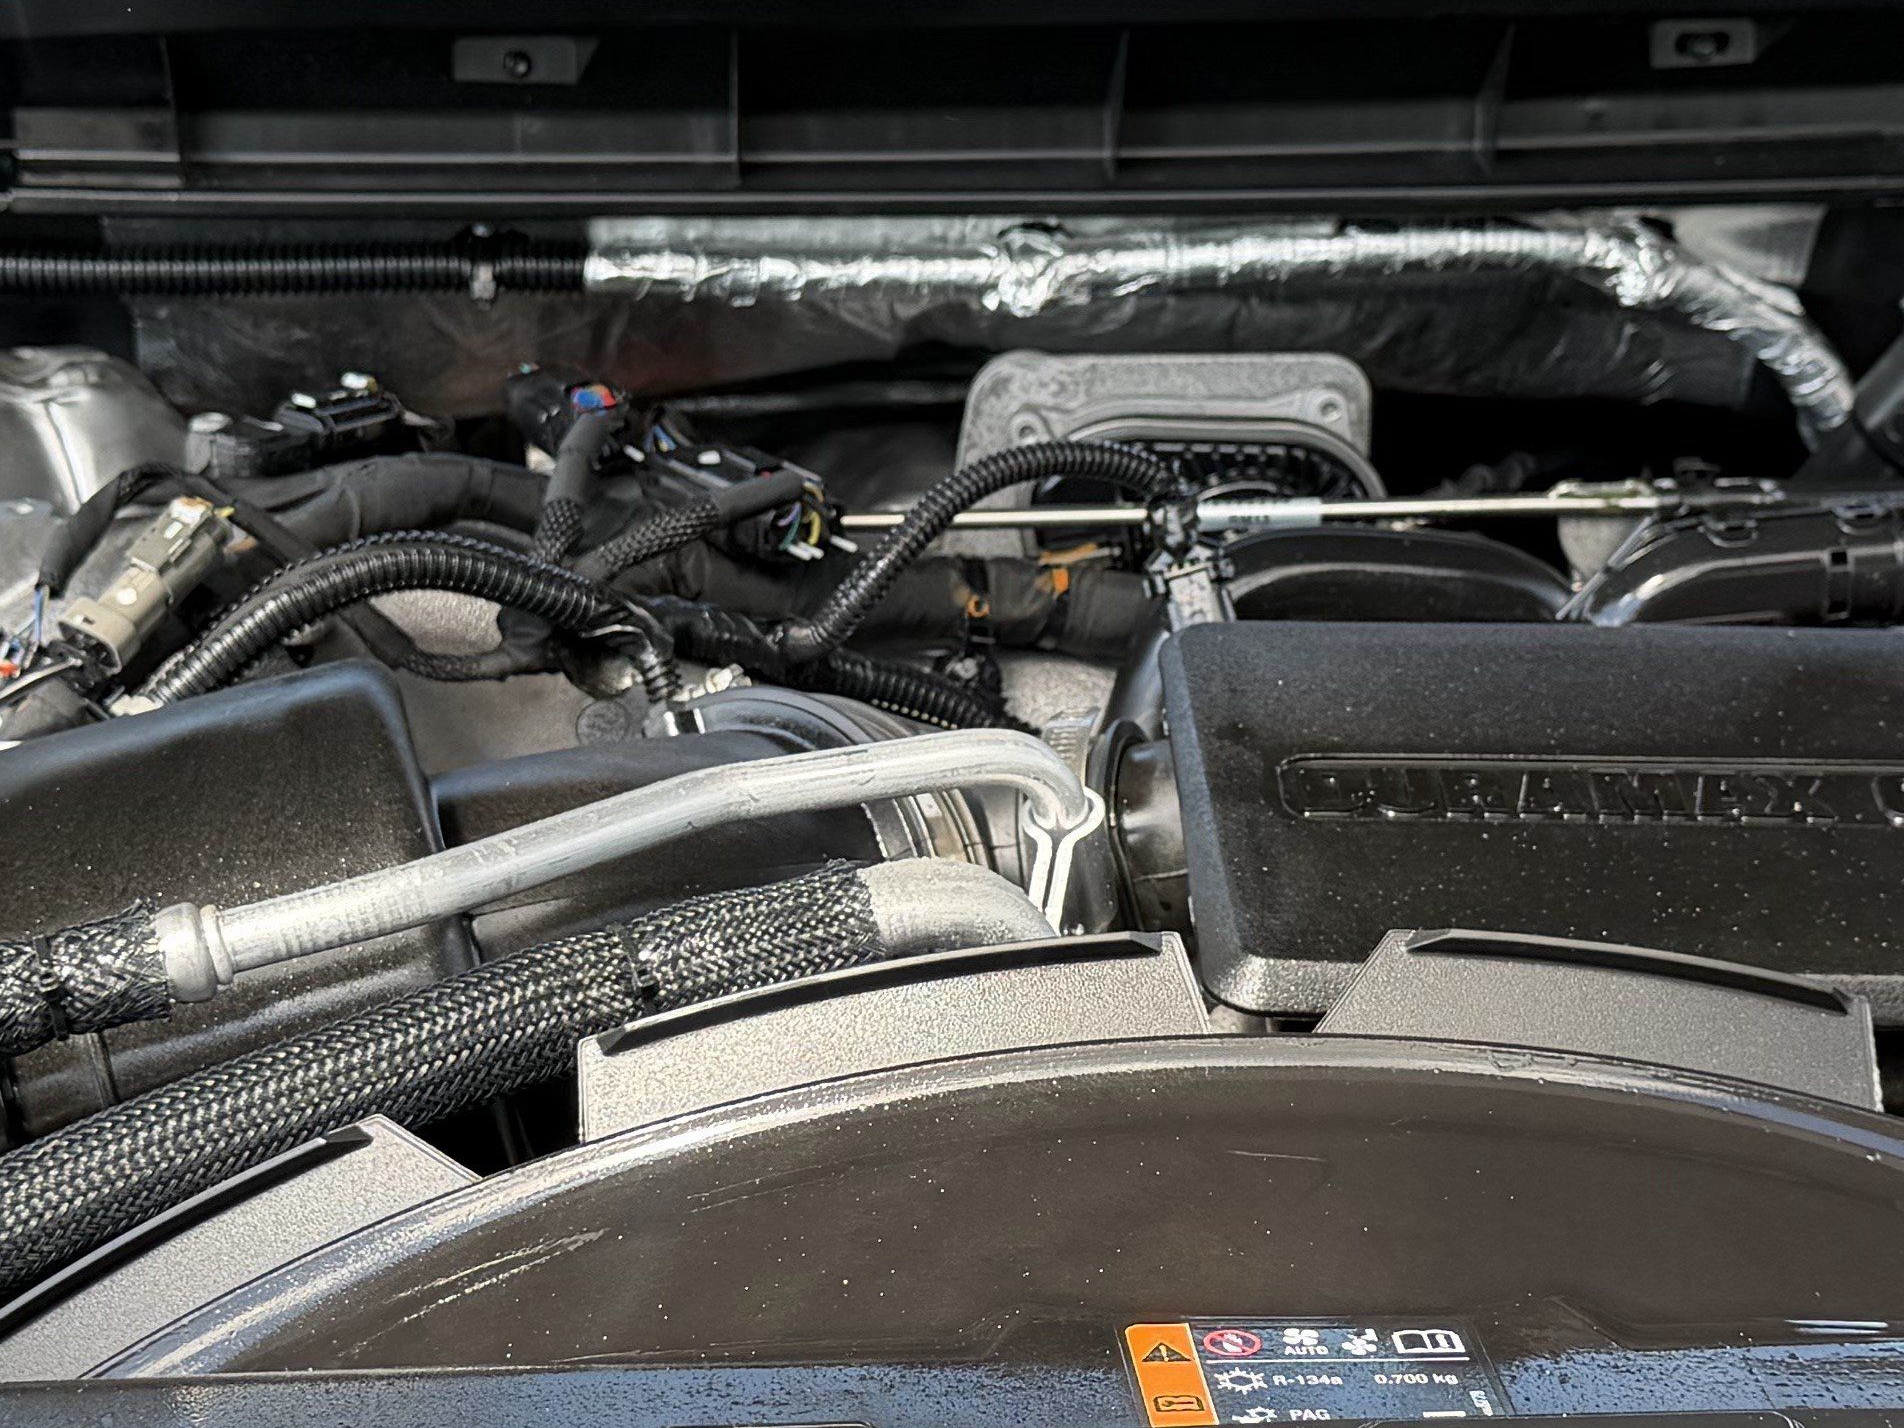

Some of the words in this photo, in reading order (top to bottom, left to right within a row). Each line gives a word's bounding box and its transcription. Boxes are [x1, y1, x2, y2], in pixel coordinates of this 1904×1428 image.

[1299, 767, 1838, 827] DURAMAX
[1284, 1345, 1329, 1356] AUTO
[1272, 1373, 1344, 1386] R-134a
[1374, 1373, 1429, 1385] 0.700
[1432, 1373, 1459, 1386] kg
[1289, 1408, 1332, 1421] PAG
